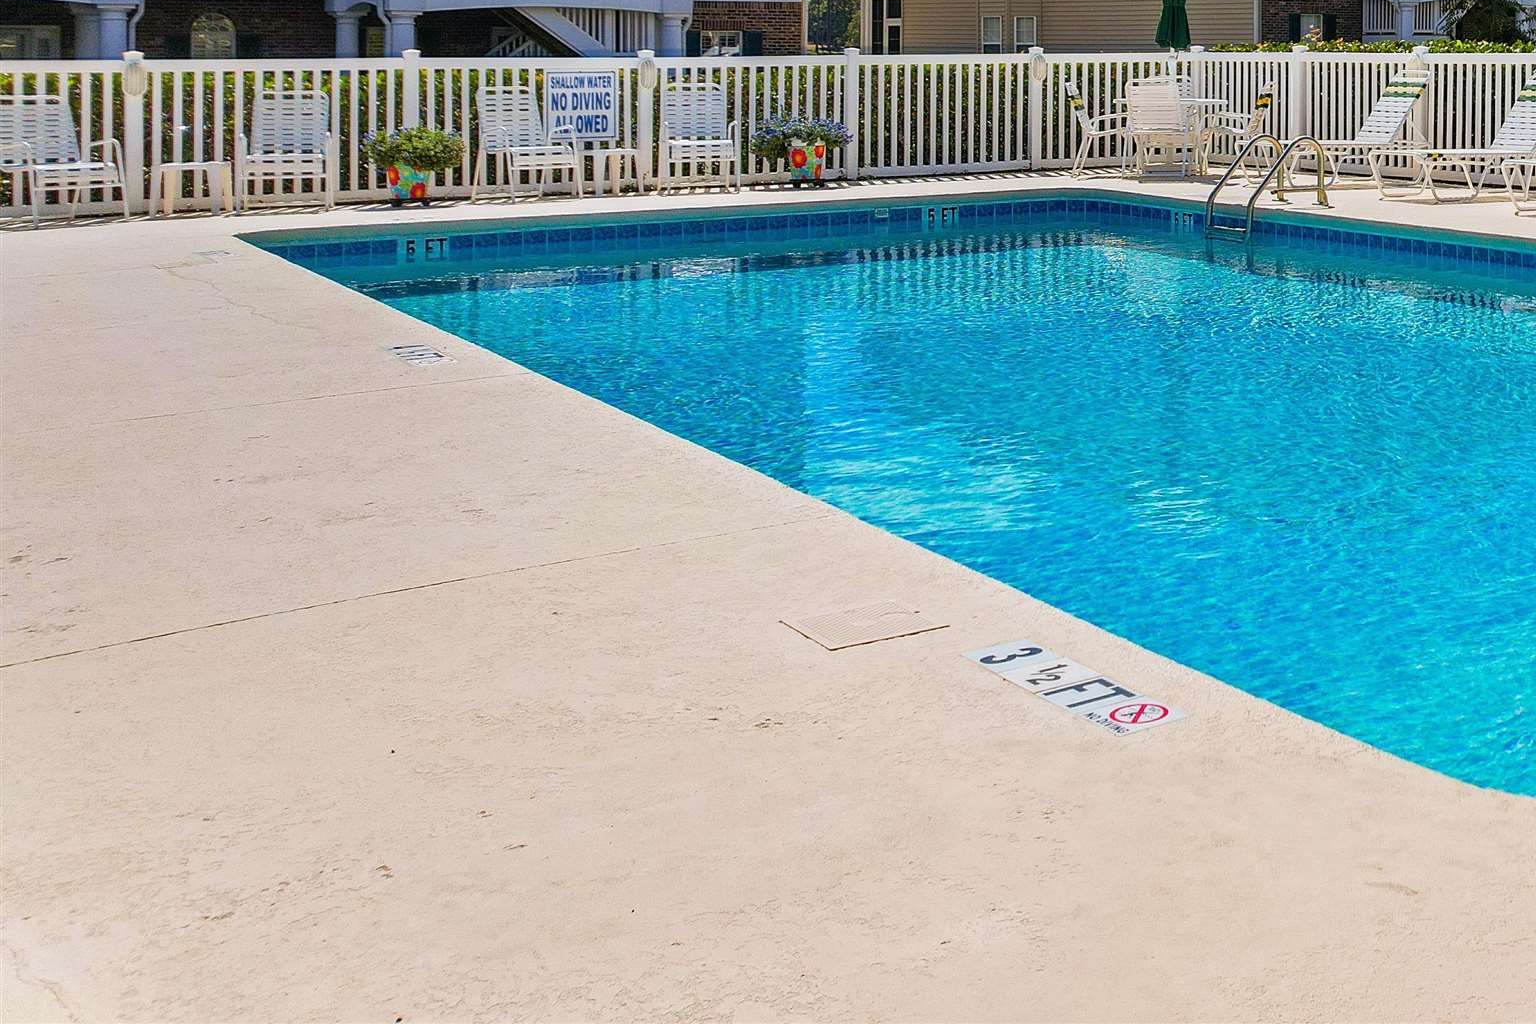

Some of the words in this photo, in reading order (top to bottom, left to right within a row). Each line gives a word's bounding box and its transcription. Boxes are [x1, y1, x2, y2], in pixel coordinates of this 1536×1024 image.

[550, 76, 584, 89] SHALLOW
[587, 75, 612, 88] WATER
[551, 92, 567, 111] NO
[572, 91, 611, 111] DIVING
[941, 206, 958, 224] FT
[425, 237, 448, 256] FT
[979, 646, 1044, 665] 3
[1042, 678, 1137, 709] FT
